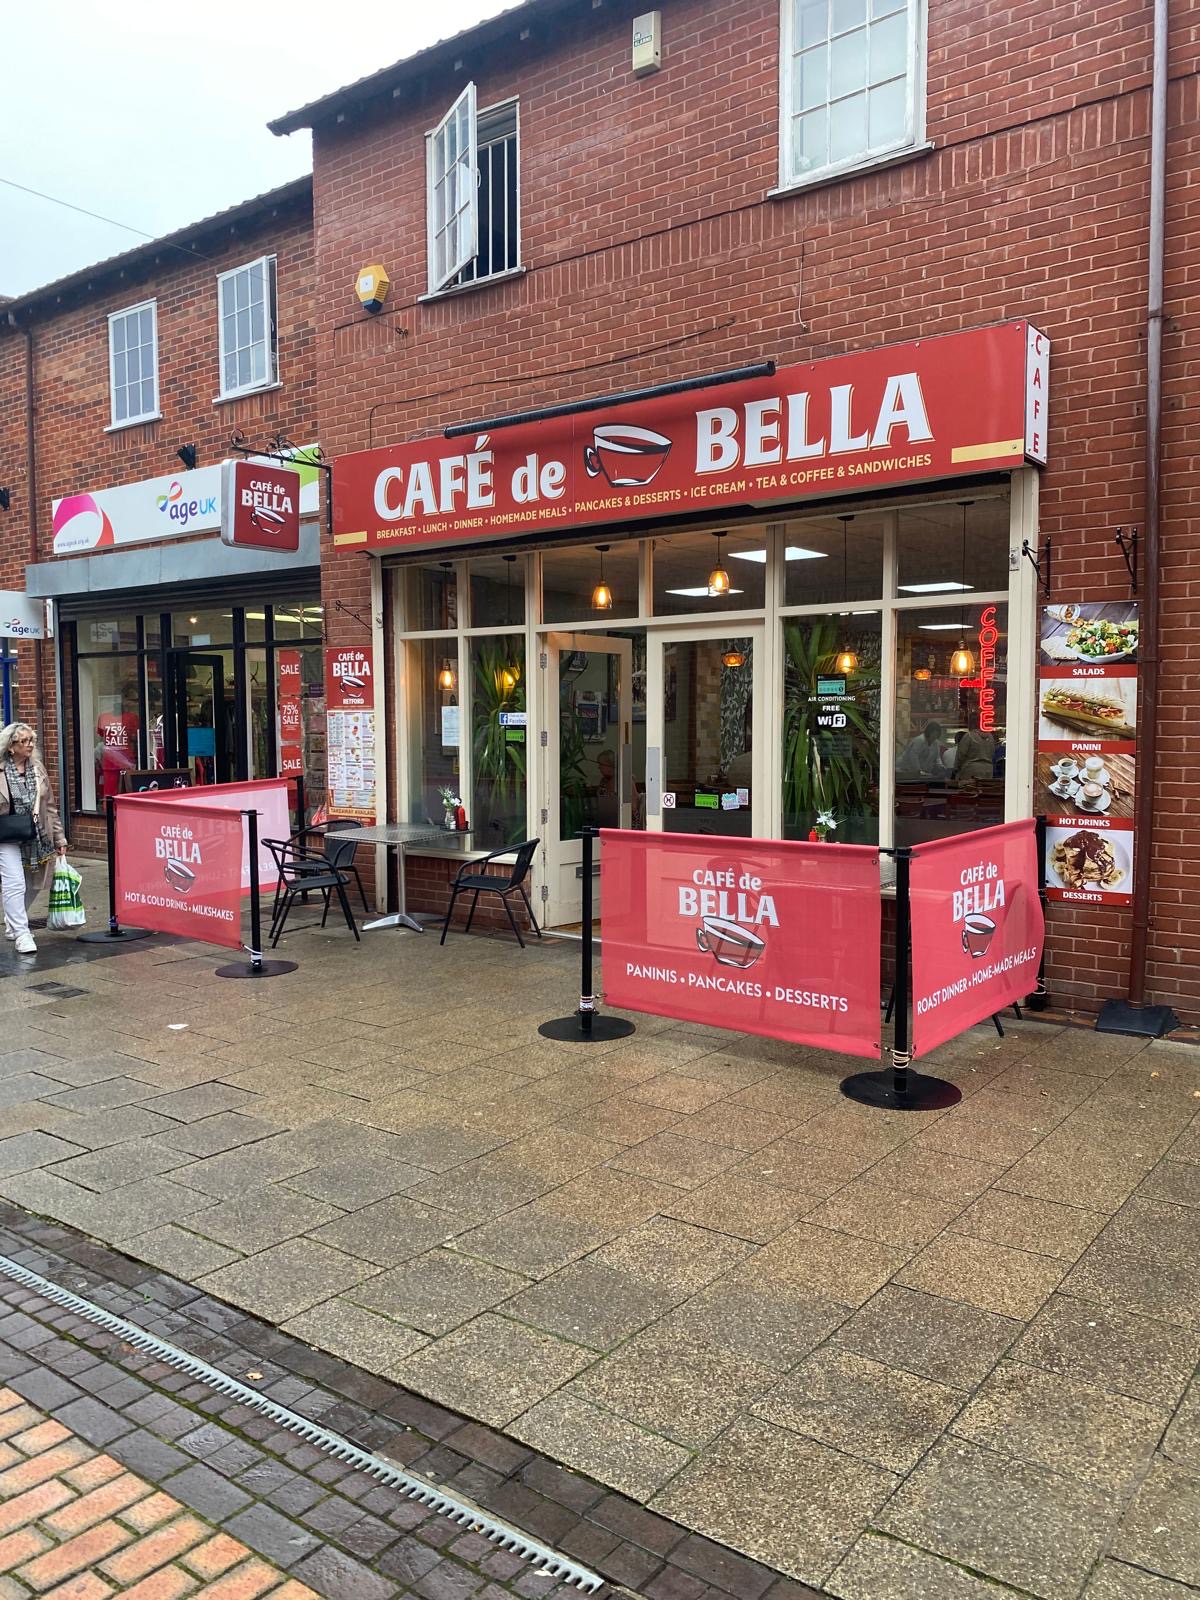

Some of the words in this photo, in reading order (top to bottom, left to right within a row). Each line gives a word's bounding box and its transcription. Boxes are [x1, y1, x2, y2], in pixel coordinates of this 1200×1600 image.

[1032, 334, 1043, 455] CAFE
[374, 434, 495, 522] CAFÉ
[511, 453, 567, 505] de
[694, 372, 935, 475] BELLA
[250, 480, 272, 492] CAFÉ
[274, 484, 286, 496] de
[376, 526, 417, 539] BREAKFAST
[422, 521, 448, 533] LUNCH
[454, 518, 483, 530] DINNER
[490, 509, 538, 525] HOMEMADE
[538, 505, 567, 518] MEALS
[575, 497, 622, 513] PANCAKES
[624, 496, 632, 507] &
[633, 489, 681, 504] DESSERTS
[690, 486, 706, 498] ICE
[708, 480, 746, 495] CREAM
[756, 476, 778, 489] TEA
[779, 475, 788, 486] &
[790, 468, 835, 485] COFFEE
[837, 466, 846, 477] &
[847, 453, 932, 477] SANDWICHES
[241, 489, 294, 514] BELLA
[338, 650, 352, 661] CAFÉ
[354, 652, 364, 661] de
[280, 664, 300, 675] SALE
[332, 662, 370, 677] BELLA
[978, 607, 998, 732] COFFEE
[1072, 668, 1105, 676] SALADS
[282, 704, 298, 715] 75%
[282, 715, 300, 725] SALE
[105, 726, 128, 736] 75%
[106, 736, 128, 746] SALE
[1072, 742, 1102, 751] PANINI
[283, 758, 302, 770] SALE
[1059, 817, 1076, 826] HOT
[1078, 818, 1110, 827] DRINKS
[160, 824, 181, 839] CAFÉ
[182, 826, 193, 838] de
[155, 837, 202, 864] BELLA
[692, 868, 734, 888] CAFÉ
[739, 872, 762, 891] de
[960, 861, 984, 886] CAFÉ
[986, 862, 998, 879] de
[952, 879, 1006, 923] BELLA
[1062, 891, 1102, 902] DESSERTS
[125, 891, 140, 903] HOT
[142, 895, 147, 904] &
[147, 894, 165, 908] COLD
[166, 898, 188, 912] DRINKS
[192, 904, 234, 922] MILKSHAKES
[678, 886, 780, 928] BELLA
[626, 963, 678, 984] PANINIS
[688, 973, 762, 998] PANCAKES
[775, 987, 849, 1012] DESSERTS
[917, 994, 942, 1016] ROAST
[942, 976, 968, 1000] DINNER
[972, 956, 1013, 984] HOME-MADE
[1014, 946, 1037, 966] MEALS
